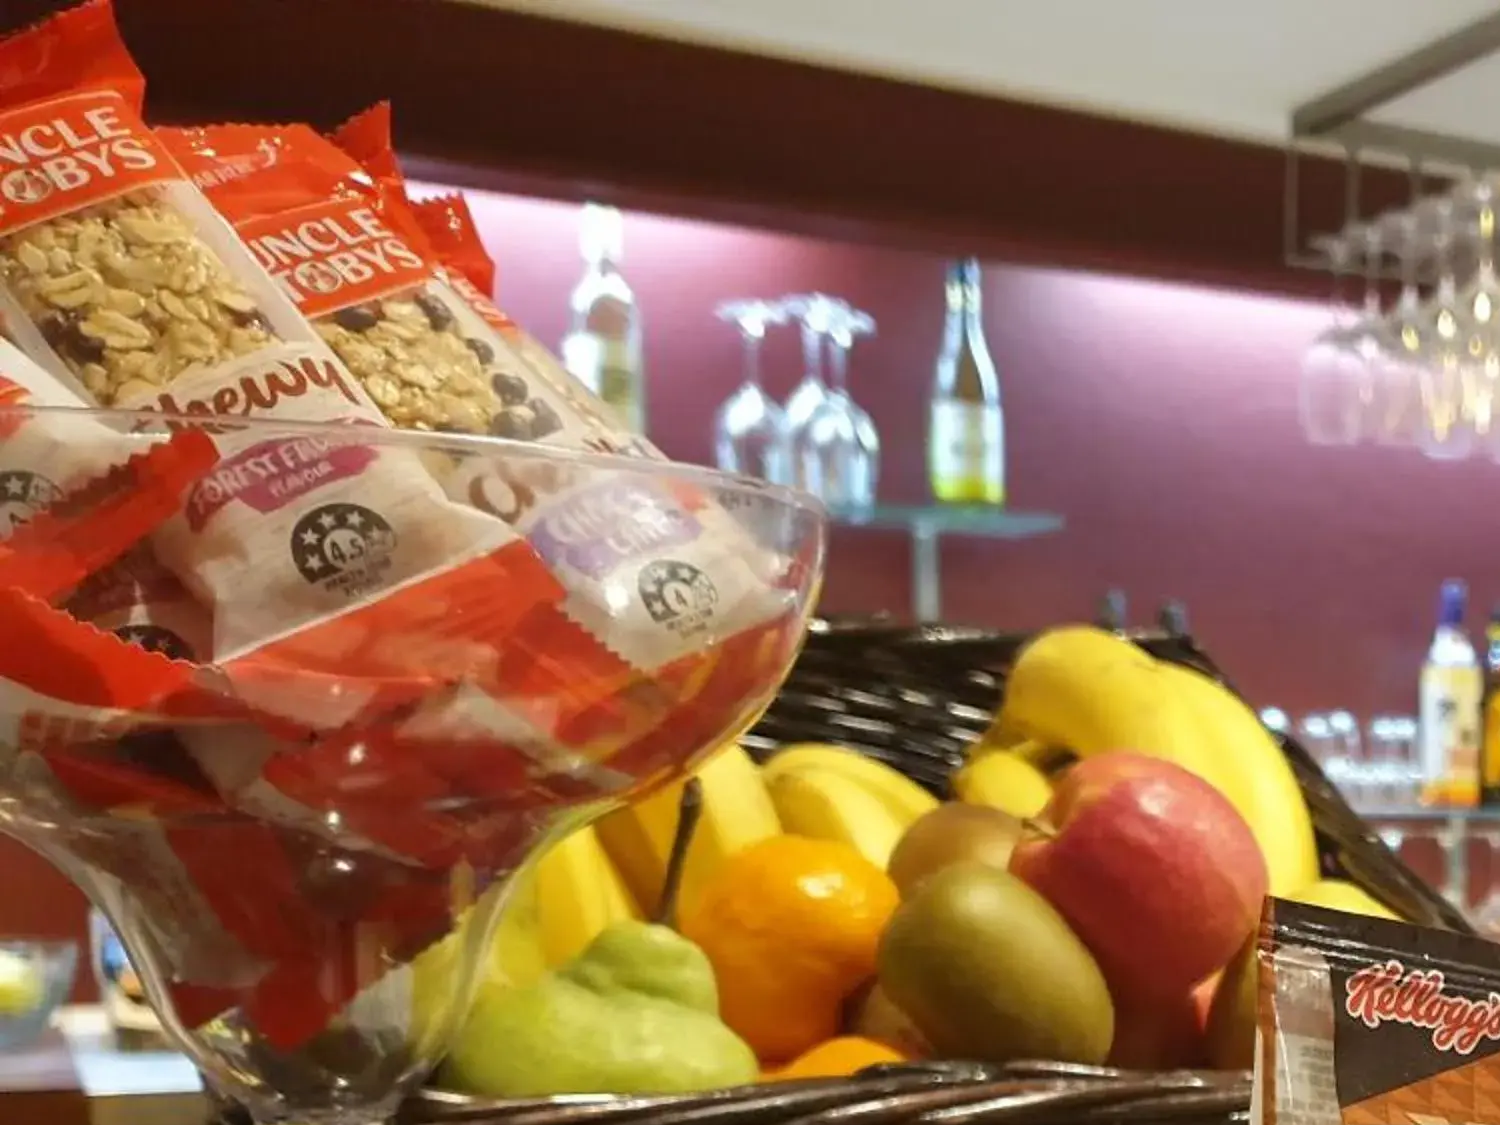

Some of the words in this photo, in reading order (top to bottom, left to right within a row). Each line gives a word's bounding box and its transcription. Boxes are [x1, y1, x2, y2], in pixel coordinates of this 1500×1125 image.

[0, 106, 131, 166] NCLE
[0, 138, 157, 207] OBYS
[275, 238, 423, 303] TOBYS
